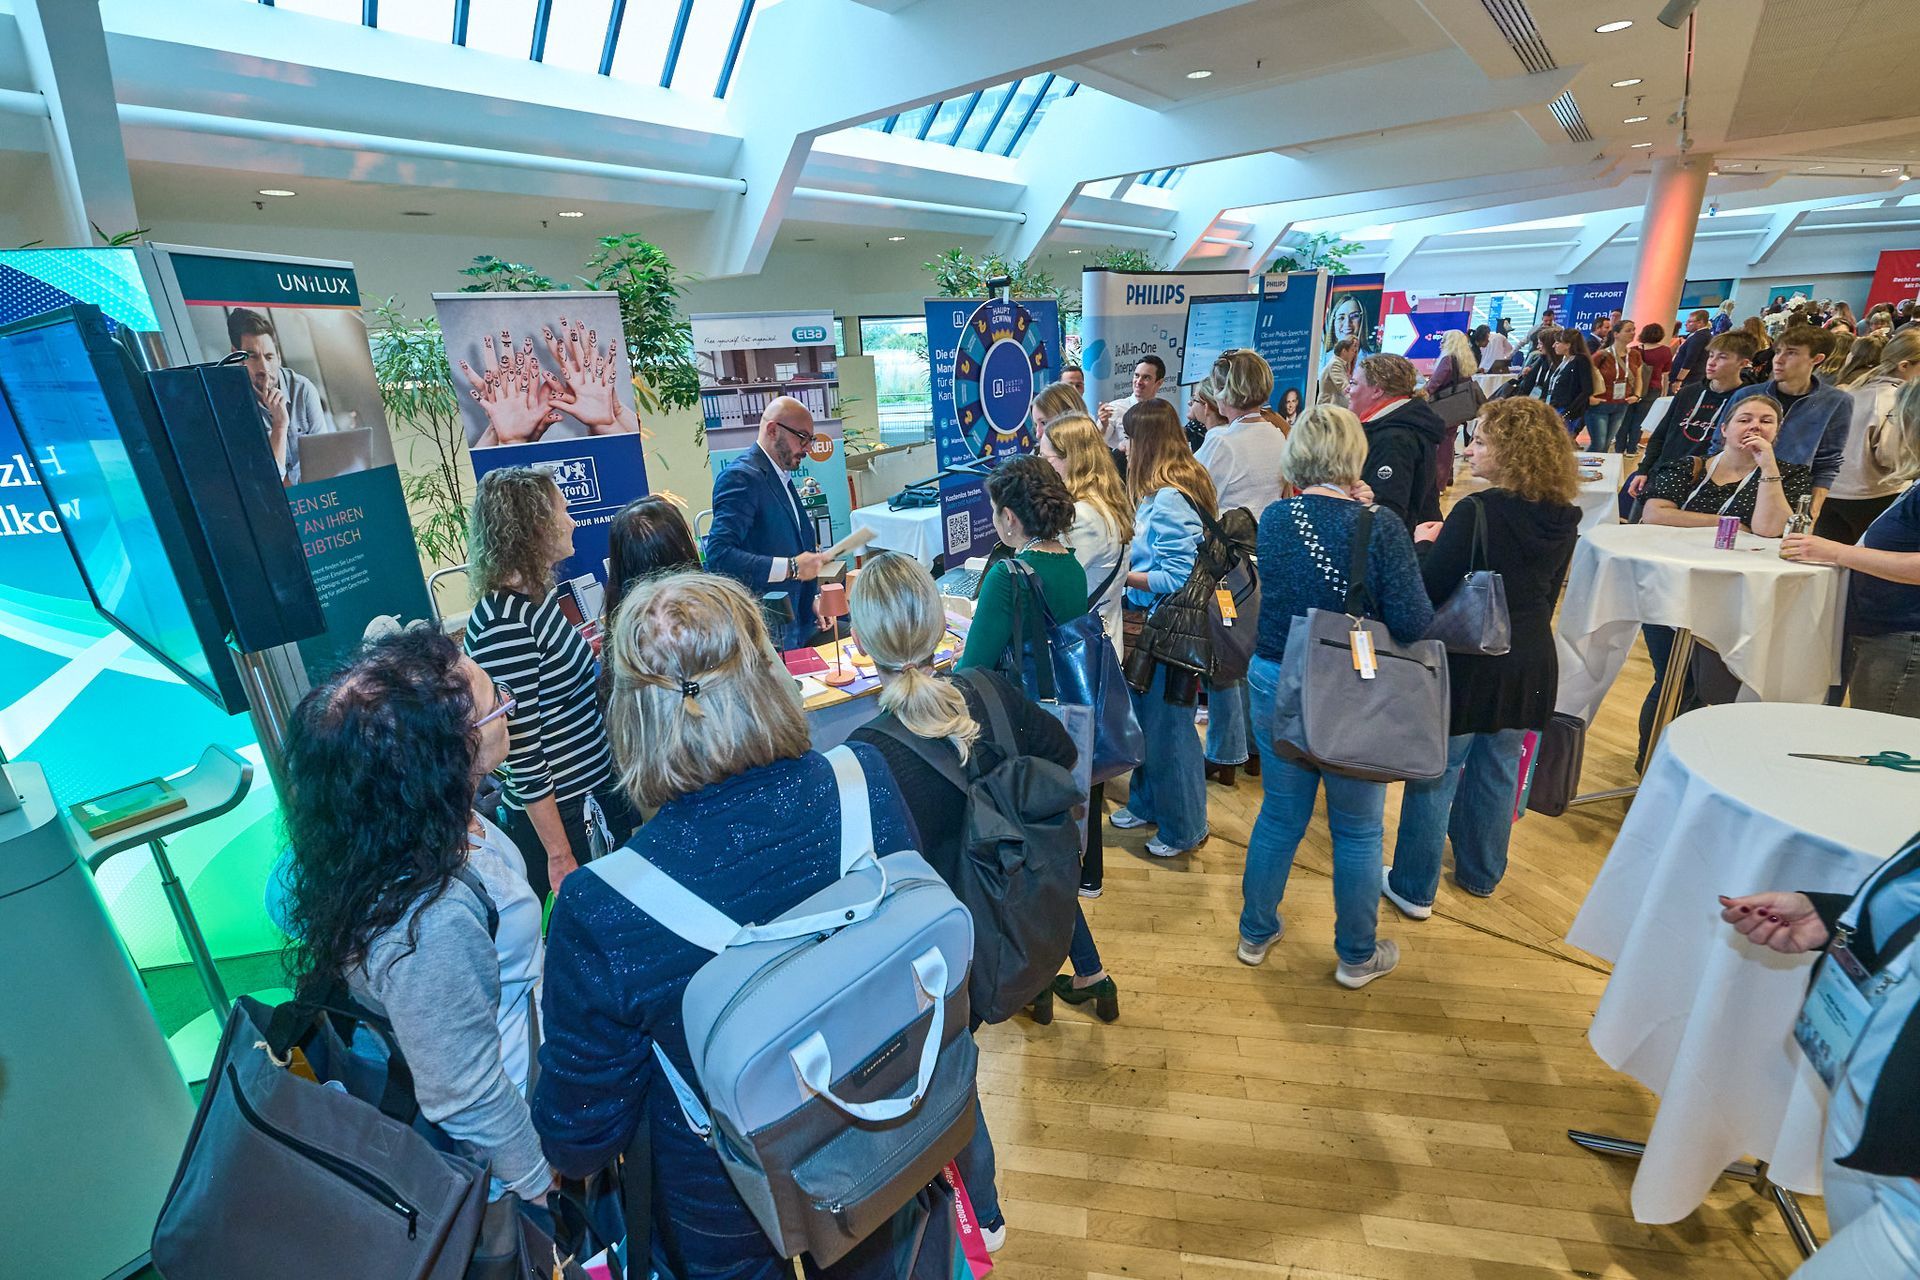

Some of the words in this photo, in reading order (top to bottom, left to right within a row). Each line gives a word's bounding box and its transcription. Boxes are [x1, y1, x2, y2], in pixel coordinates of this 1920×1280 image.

[1126, 284, 1185, 305] PHILIPS
[1584, 291, 1624, 299] ACTAPORT
[992, 307, 1010, 316] HAUPT
[1576, 311, 1592, 320] Ihr
[1594, 310, 1612, 319] na
[991, 315, 1012, 325] GEWINN
[1121, 342, 1157, 356] All-in-One
[935, 349, 949, 360] Die
[937, 378, 948, 388] für
[561, 481, 590, 498] ford
[320, 491, 340, 509] SIE
[304, 517, 325, 536] AN
[326, 506, 364, 530] IHREN
[576, 518, 592, 528] OUR
